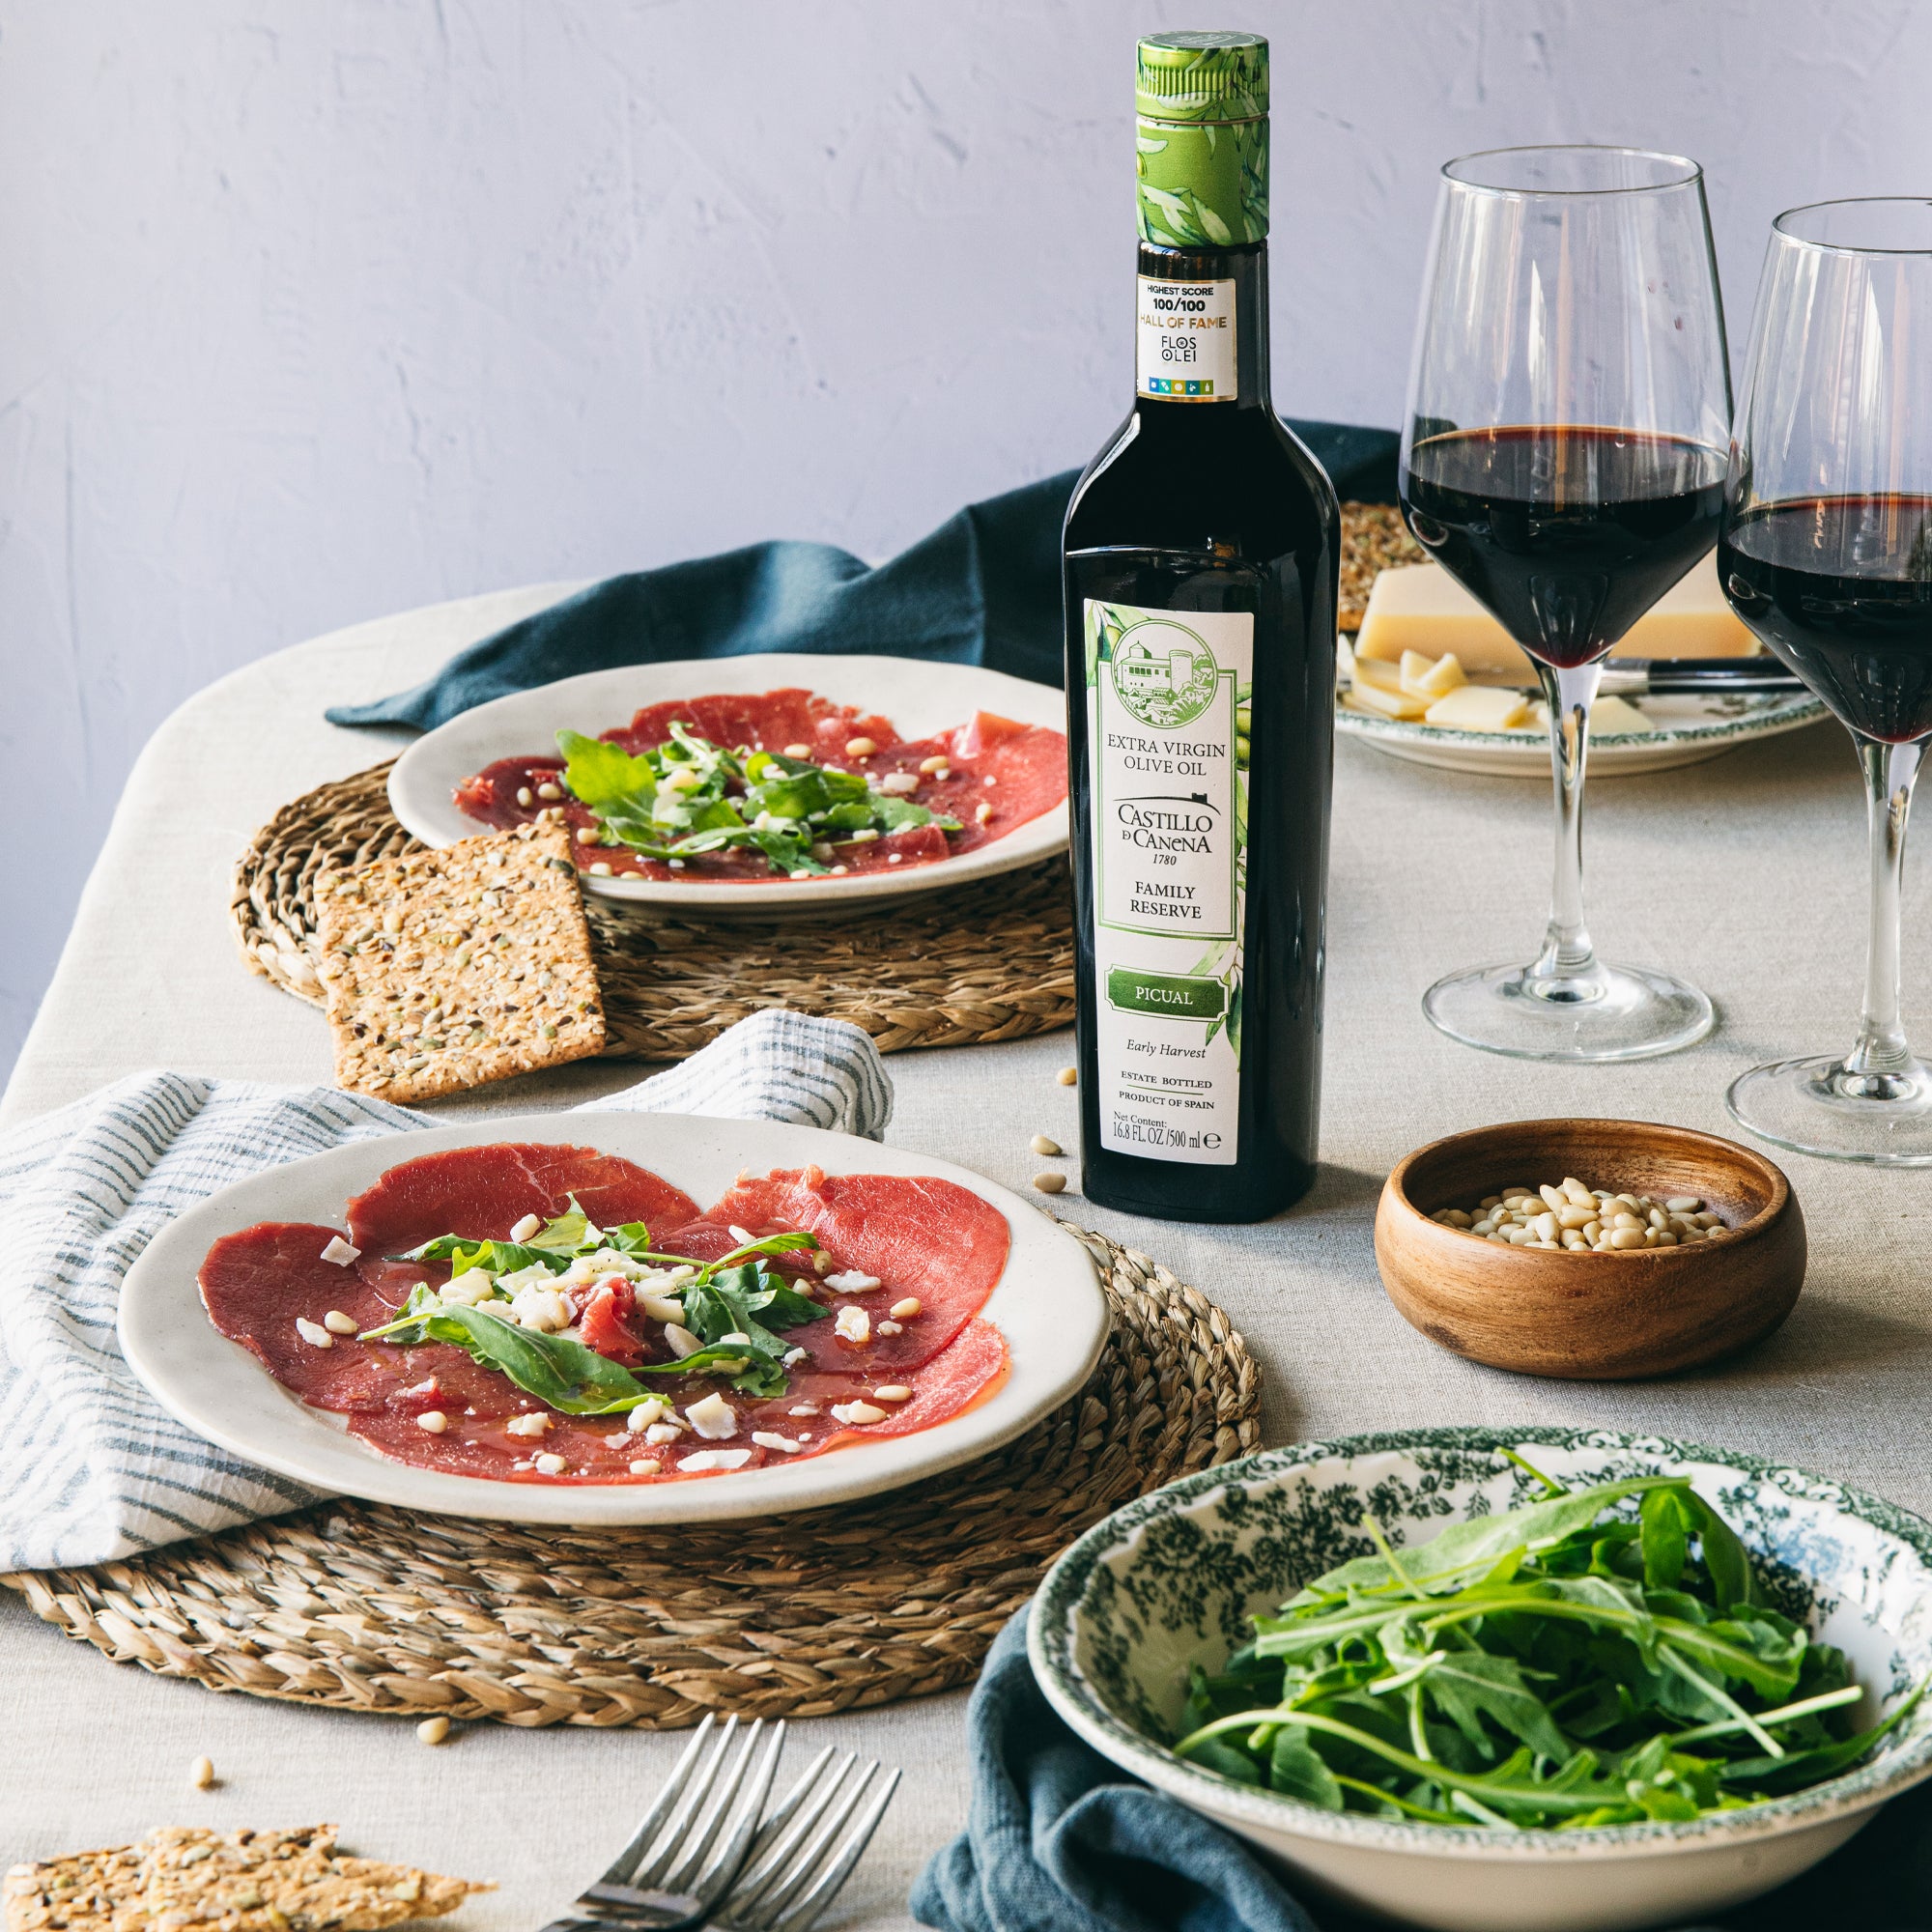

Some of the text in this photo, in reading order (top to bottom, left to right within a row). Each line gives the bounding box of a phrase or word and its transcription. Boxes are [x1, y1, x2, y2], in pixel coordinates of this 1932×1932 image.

[1148, 284, 1213, 296] HIGHEST SCORE
[1153, 298, 1206, 311] 100/100
[1167, 317, 1184, 328] OF
[1189, 317, 1227, 328] FAME
[1162, 336, 1196, 349] FLOS
[1162, 349, 1196, 361] OLEI
[1108, 734, 1226, 756] EXTRA VIRGIN
[1123, 756, 1207, 776] OLIVE OIL
[1152, 854, 1177, 866] 1780
[1135, 881, 1196, 899] FAMILY
[1130, 899, 1202, 919] RESERVE
[1135, 986, 1193, 1005] PICUAL
[1126, 1039, 1206, 1059] Early Harvest
[1121, 1071, 1212, 1089] ESTATE BOTTLED
[1119, 1091, 1165, 1105] PRODUCT
[1184, 1100, 1215, 1109] SPAIN
[1114, 1111, 1167, 1128] Net Content:
[1113, 1122, 1130, 1138] 16.8
[1132, 1125, 1146, 1142] FL.
[1189, 1131, 1201, 1149] ml
